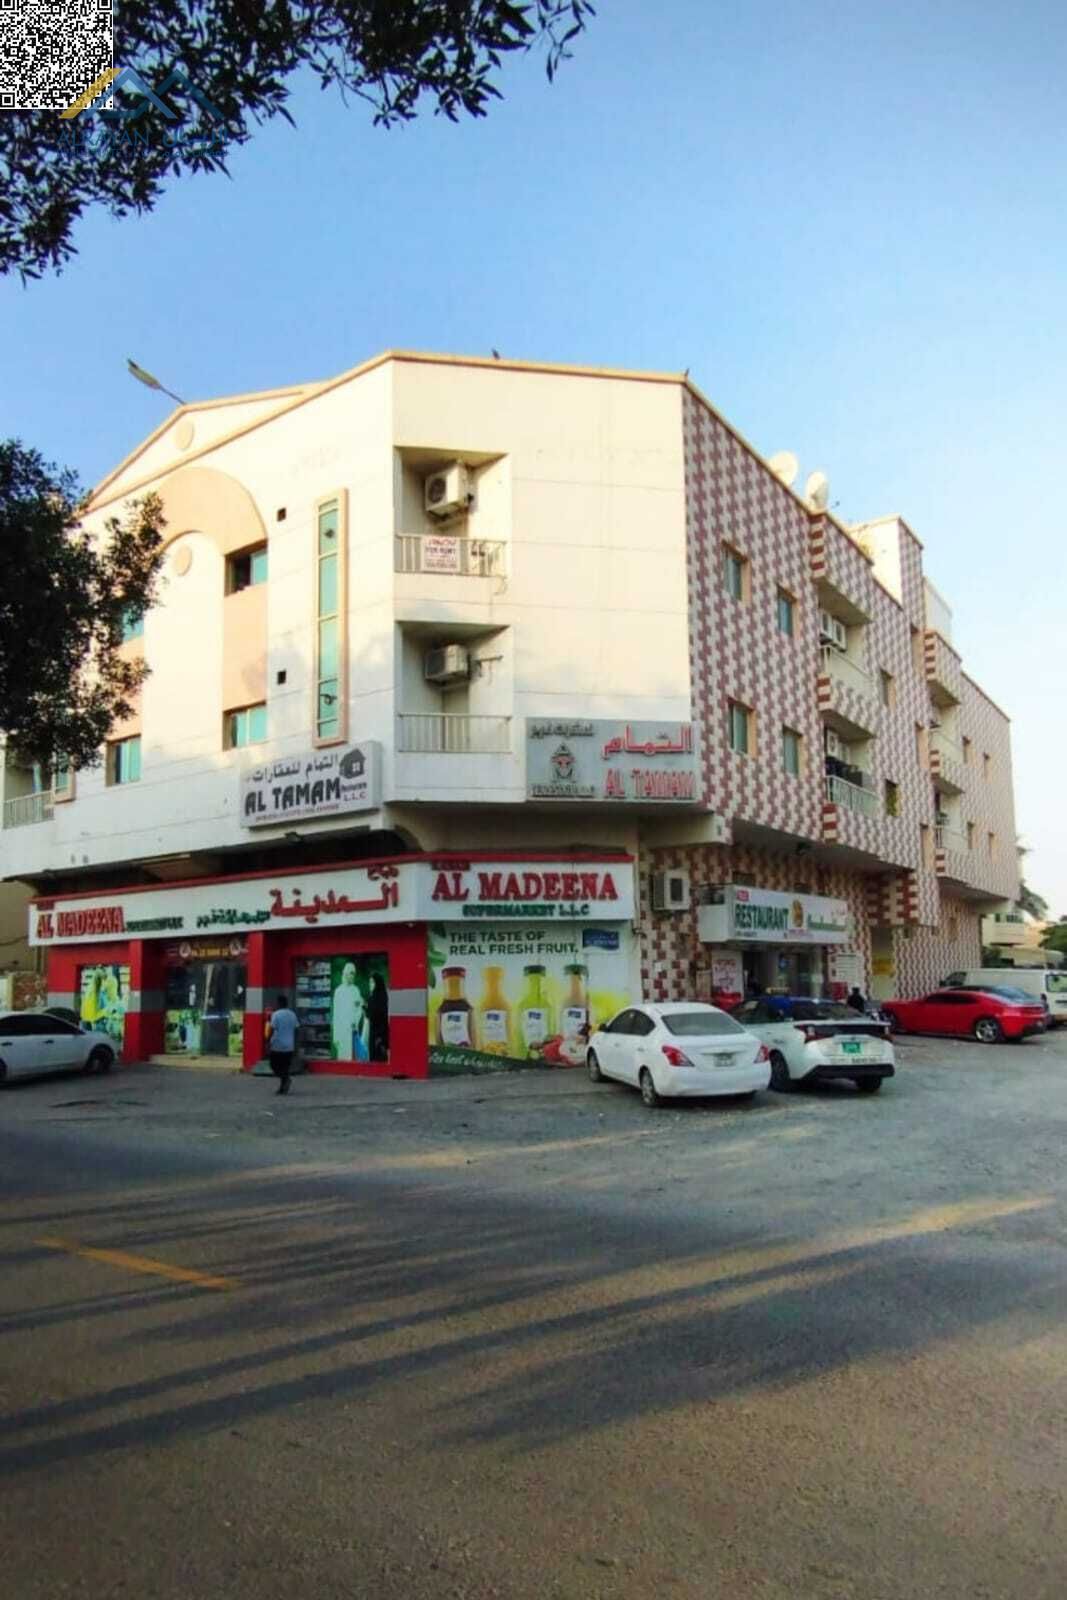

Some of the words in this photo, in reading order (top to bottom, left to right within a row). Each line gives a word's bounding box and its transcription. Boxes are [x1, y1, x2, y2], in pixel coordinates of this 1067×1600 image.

[602, 724, 695, 760] التمام
[245, 790, 266, 816] AL
[272, 777, 340, 810] TAMAM
[603, 768, 626, 798] AL
[432, 872, 469, 901] AL
[478, 872, 618, 901] MADEENA
[269, 881, 399, 924] المدينة
[462, 904, 555, 918] SUPERMARKET
[735, 903, 790, 930] RESTAURANT
[37, 913, 54, 938] AL
[57, 906, 126, 937] MADEENA
[450, 931, 477, 943] THE
[481, 931, 522, 943] TASTE
[525, 930, 545, 942] OF
[450, 945, 485, 956] REAL
[489, 944, 534, 955] FRESH
[537, 942, 579, 954] FRUIT.
